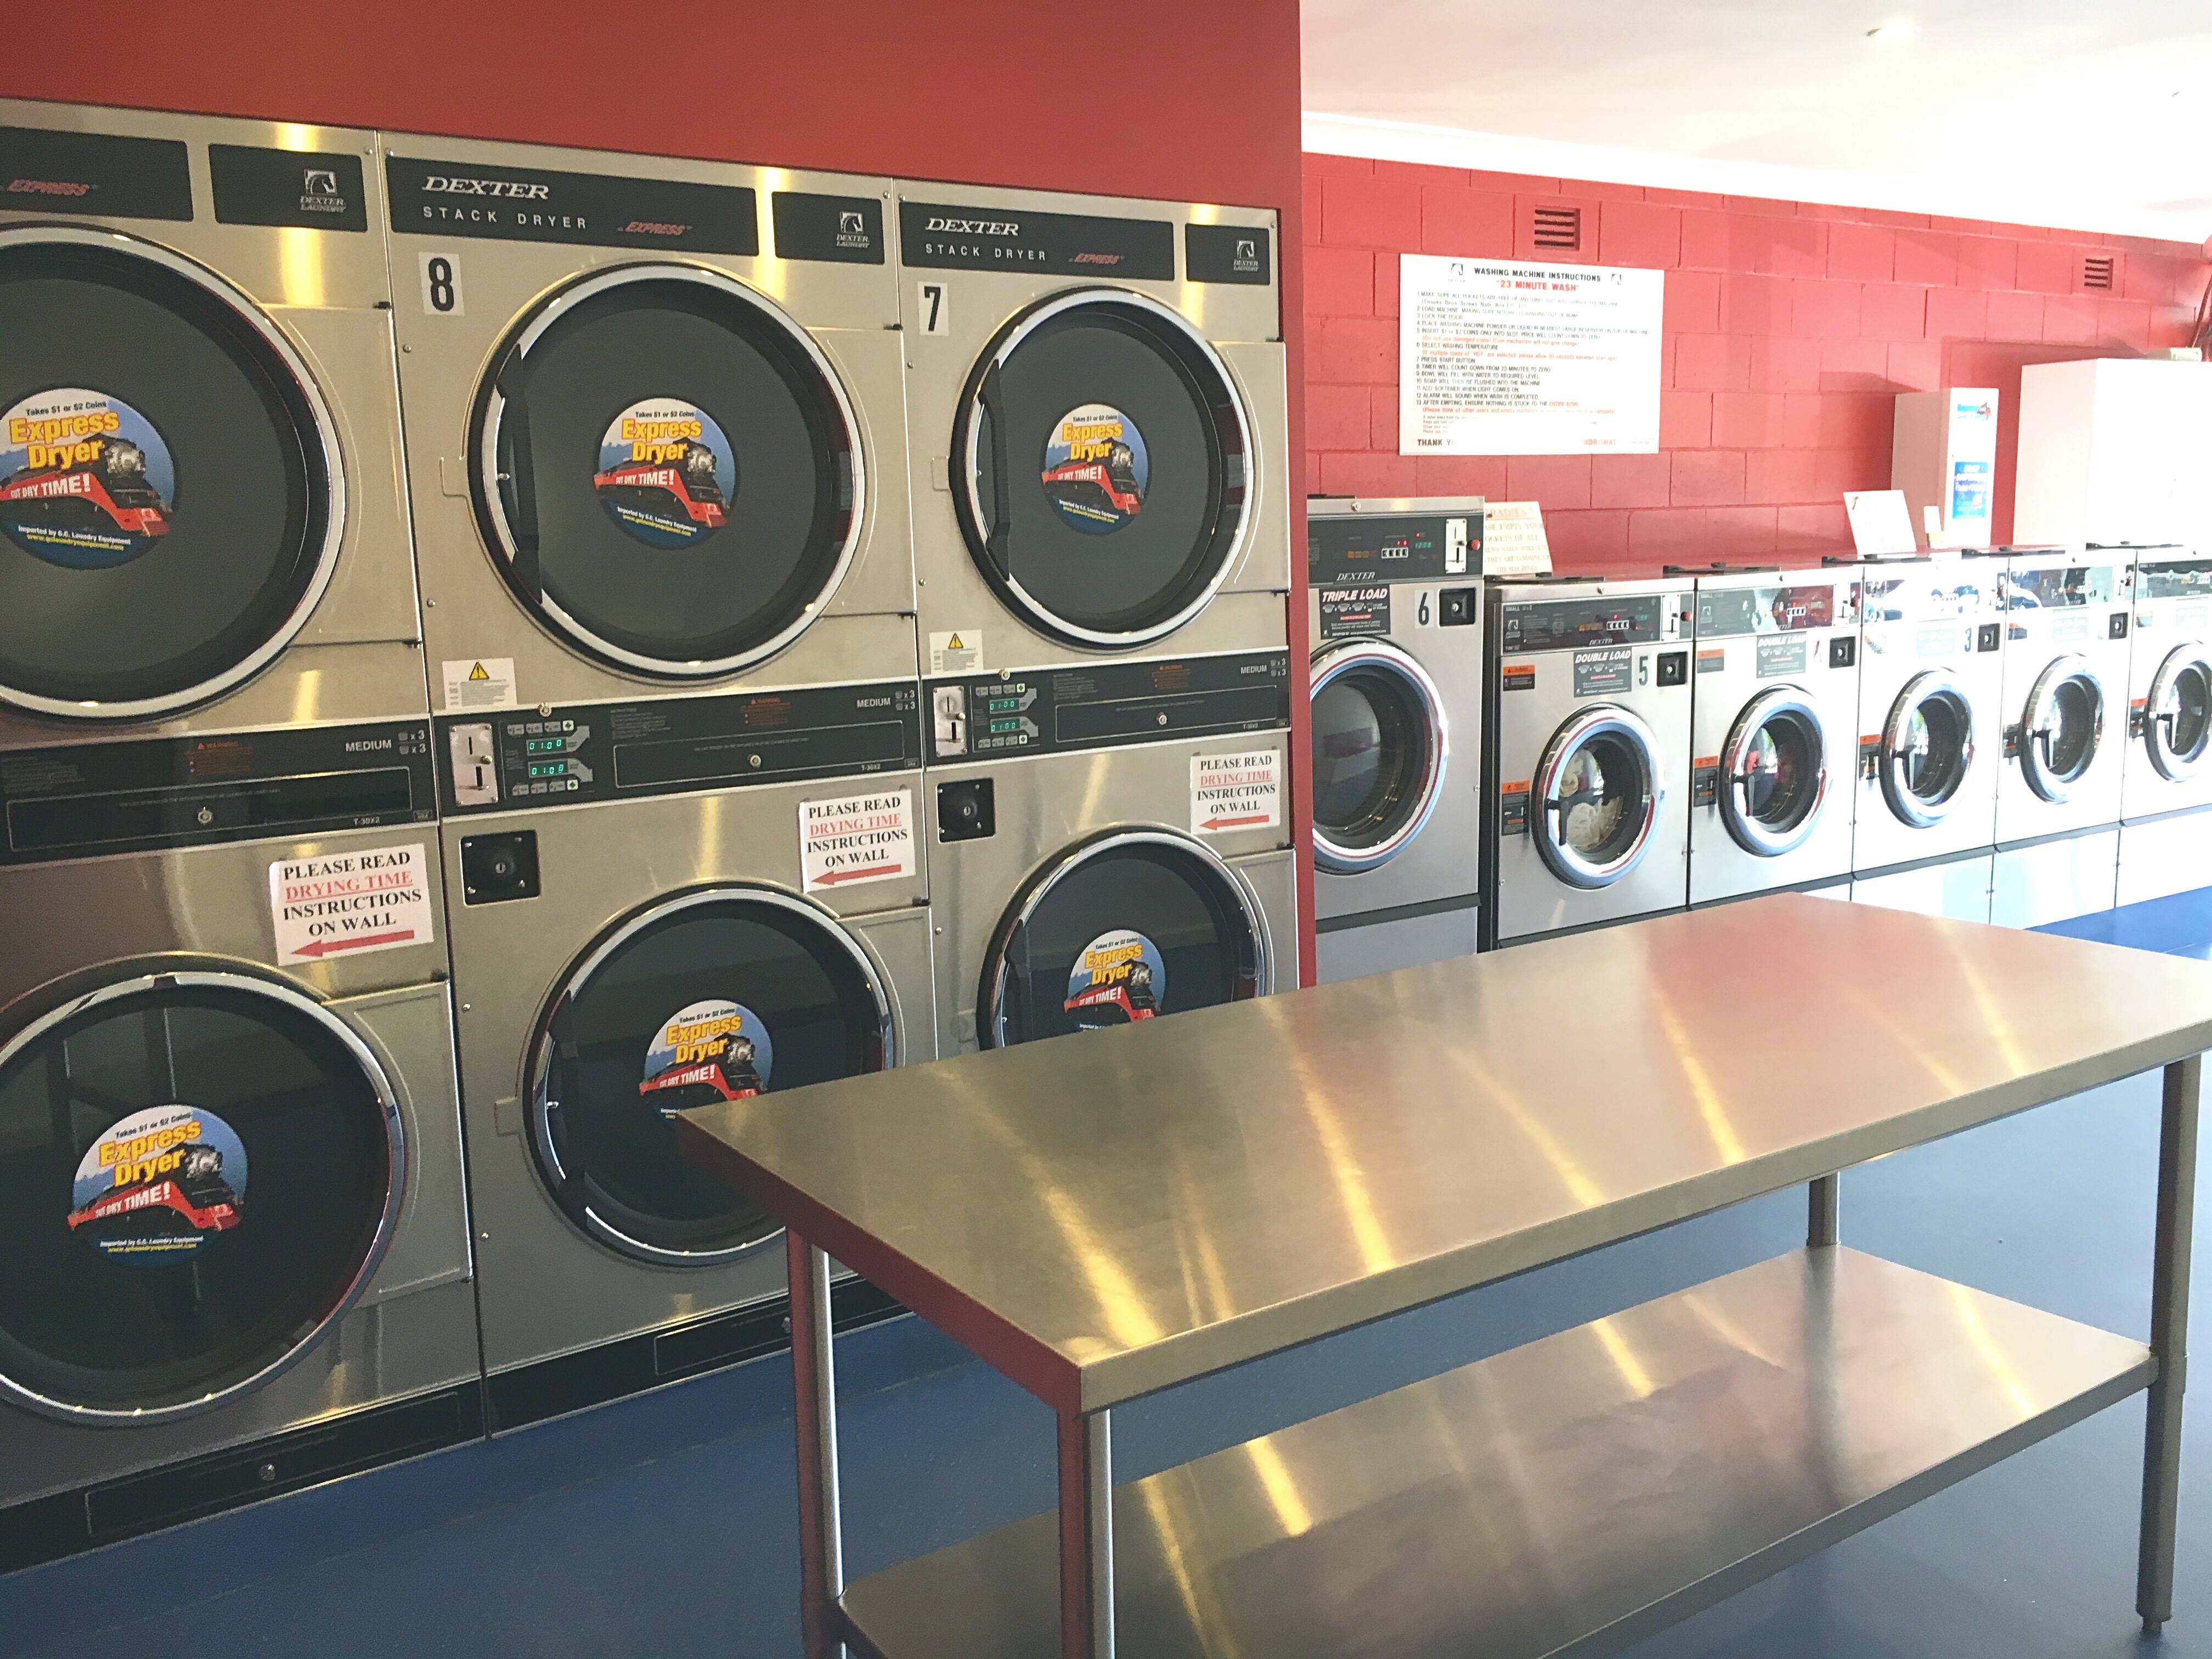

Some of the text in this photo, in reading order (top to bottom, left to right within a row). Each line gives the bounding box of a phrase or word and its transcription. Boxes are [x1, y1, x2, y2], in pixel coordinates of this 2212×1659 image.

[422, 176, 549, 200] DEXTER
[424, 206, 588, 230] STACK DRYER
[625, 221, 687, 235] EXPRESS
[926, 217, 1019, 236] DEXTER
[926, 244, 1046, 261] STACK DRYER
[427, 257, 454, 312] 8
[1475, 268, 1601, 281] WASHING MACHINE INSTRUCTIONS
[1516, 281, 1547, 290] MINUTE
[924, 286, 941, 331] 7
[86, 401, 106, 409] Coins
[9, 412, 120, 445] Express
[622, 419, 702, 442] Express
[1063, 422, 1123, 443] Express
[27, 439, 104, 471] Dryer
[632, 441, 689, 464] Dryer
[1070, 442, 1113, 462] Dryer
[624, 469, 674, 486] DRY TIME!
[1075, 466, 1102, 481] TIME!
[22, 484, 38, 497] DRY
[41, 473, 90, 496] TIME!
[1337, 572, 1375, 580] DEXTER
[1322, 588, 1388, 602] TRIPLE LOAD
[1418, 592, 1429, 625] 6
[1758, 633, 1806, 647] DOUBLE LOAD
[1963, 628, 1972, 652] 3
[1575, 651, 1630, 663] DOUBLE LOAD
[1241, 665, 1267, 674] MEDIUM
[1639, 656, 1648, 685] 5
[857, 698, 891, 708] MEDIUM
[346, 740, 392, 752] MEDIUM
[1200, 755, 1272, 770] PLEASE READ
[1200, 770, 1272, 786] DRYING TIME
[1198, 784, 1276, 801] INSTRUCTIONS
[809, 797, 900, 819] PLEASE READ
[1211, 800, 1260, 814] ON WALL
[810, 813, 901, 836] DRYING TIME
[808, 829, 908, 853] INSTRUCTIONS
[284, 851, 410, 881] PLEASE READ
[826, 849, 889, 867] ON WALL
[285, 871, 413, 900] DRYING TIME
[283, 889, 422, 921] INSTRUCTIONS
[308, 912, 396, 936] ON WALL
[1085, 944, 1143, 969] Express
[1092, 963, 1133, 985] Dryer
[1096, 986, 1122, 1002] TIME!
[665, 1015, 742, 1046] Express
[675, 1037, 728, 1064] Dryer
[681, 1064, 715, 1084] TIME!
[99, 1121, 201, 1167] Express
[114, 1148, 185, 1188] Dryer
[124, 1181, 171, 1210] TIME!
